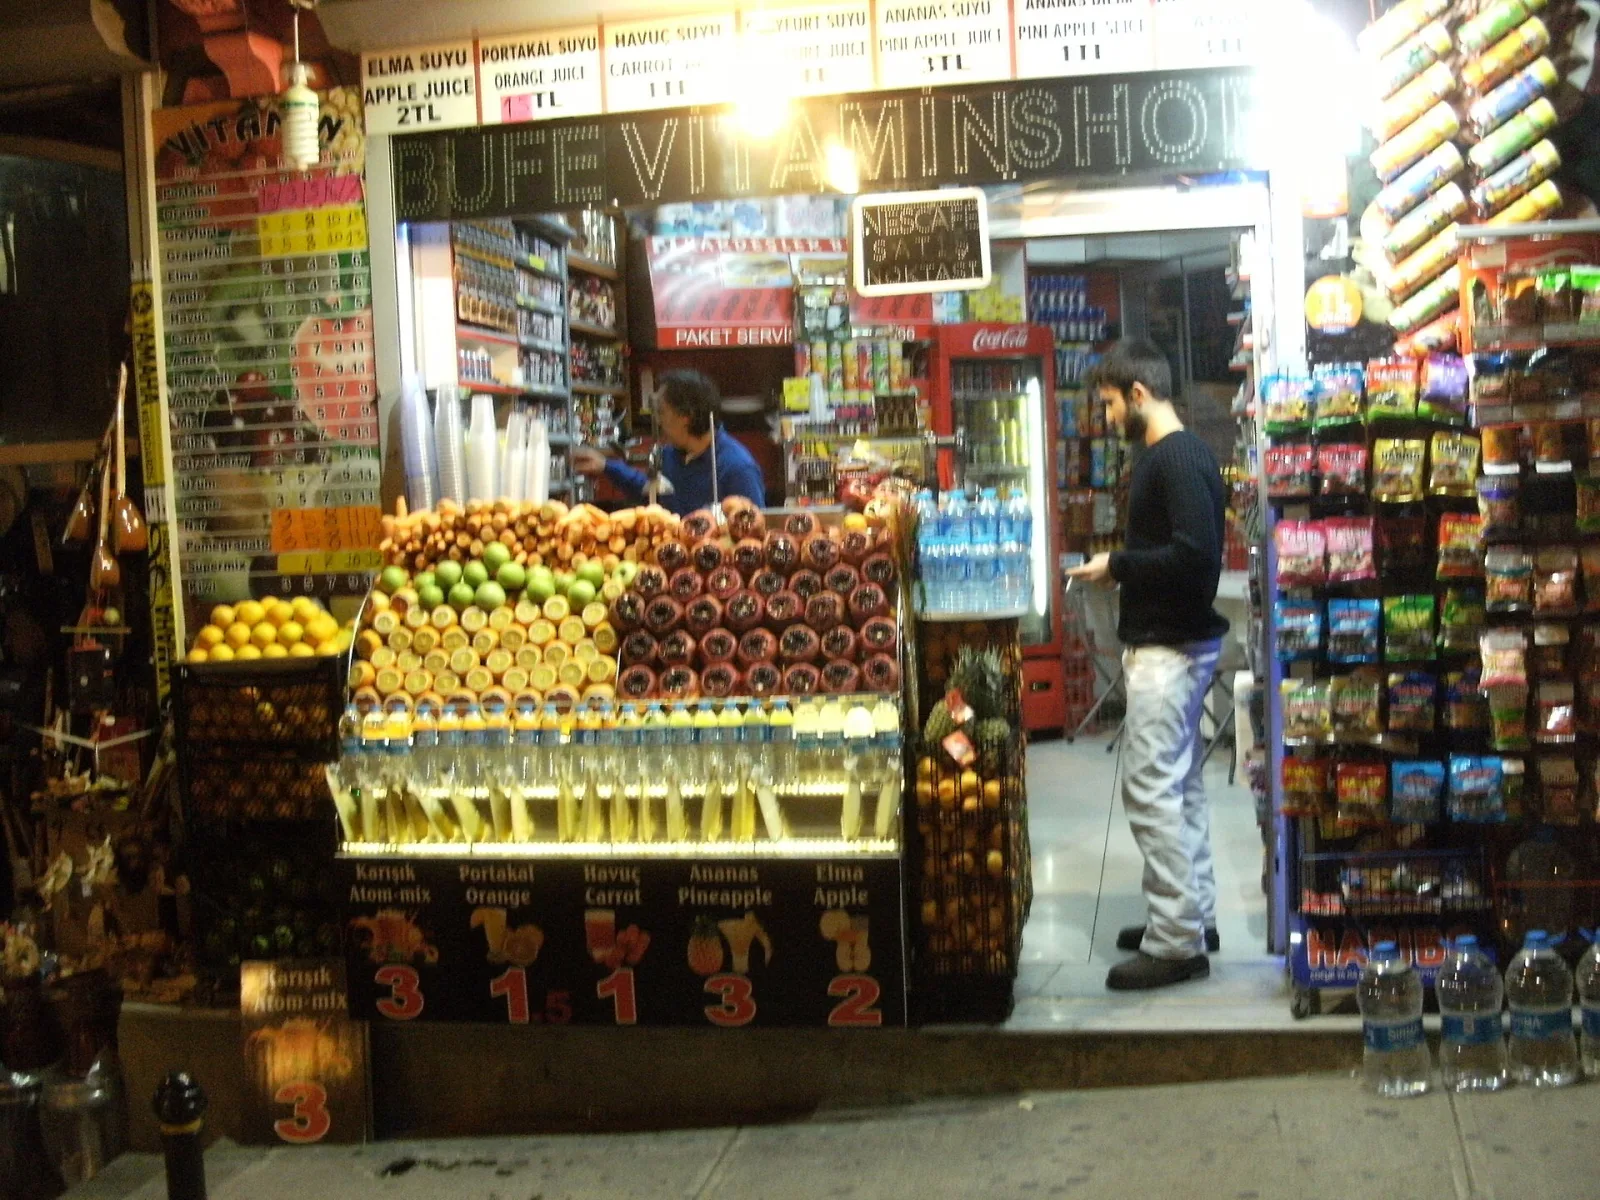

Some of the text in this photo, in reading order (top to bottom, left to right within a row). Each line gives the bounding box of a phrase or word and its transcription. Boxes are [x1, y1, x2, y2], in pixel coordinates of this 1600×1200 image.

[885, 0, 992, 23] ANANAS SUYU
[615, 23, 722, 48] HAVUÇ SUYU
[481, 36, 597, 63] PORTAKAL SUYU
[368, 48, 467, 77] ELMA SUYU
[494, 65, 586, 91] ORANGE JUICE
[364, 76, 474, 106] APPLE JUICE
[397, 102, 442, 125] 2TL
[307, 256, 318, 271] 4
[329, 253, 339, 269] 5
[351, 251, 362, 268] 6
[309, 277, 319, 292] 4
[331, 274, 341, 290] 5
[353, 273, 363, 289] 6
[332, 296, 342, 312] 4
[333, 317, 343, 333] 4
[356, 316, 366, 331] 5
[314, 342, 322, 355] 7
[335, 341, 343, 354] 9
[352, 339, 366, 353] 11
[676, 328, 732, 346] PAKET
[315, 363, 323, 377] 7
[336, 362, 344, 376] 9
[352, 360, 366, 375] 11
[315, 385, 324, 399] 5
[337, 384, 346, 398] 7
[360, 382, 369, 397] 9
[316, 406, 326, 421] 5
[338, 404, 348, 419] 7
[361, 403, 370, 417] 9
[339, 427, 348, 440] 9
[459, 863, 534, 883] Portakal
[584, 863, 641, 885] Havuç
[689, 863, 759, 883] Ananas
[816, 863, 864, 883] Elma
[466, 886, 531, 908] Orange
[585, 886, 642, 905] Carrot
[678, 886, 773, 908] Pineapple
[814, 886, 869, 909] Apple
[374, 964, 425, 1021] 3
[490, 966, 530, 1024] 1
[597, 966, 637, 1025] 1
[703, 972, 757, 1028] 3
[827, 973, 883, 1028] 2
[274, 1080, 331, 1144] 3
